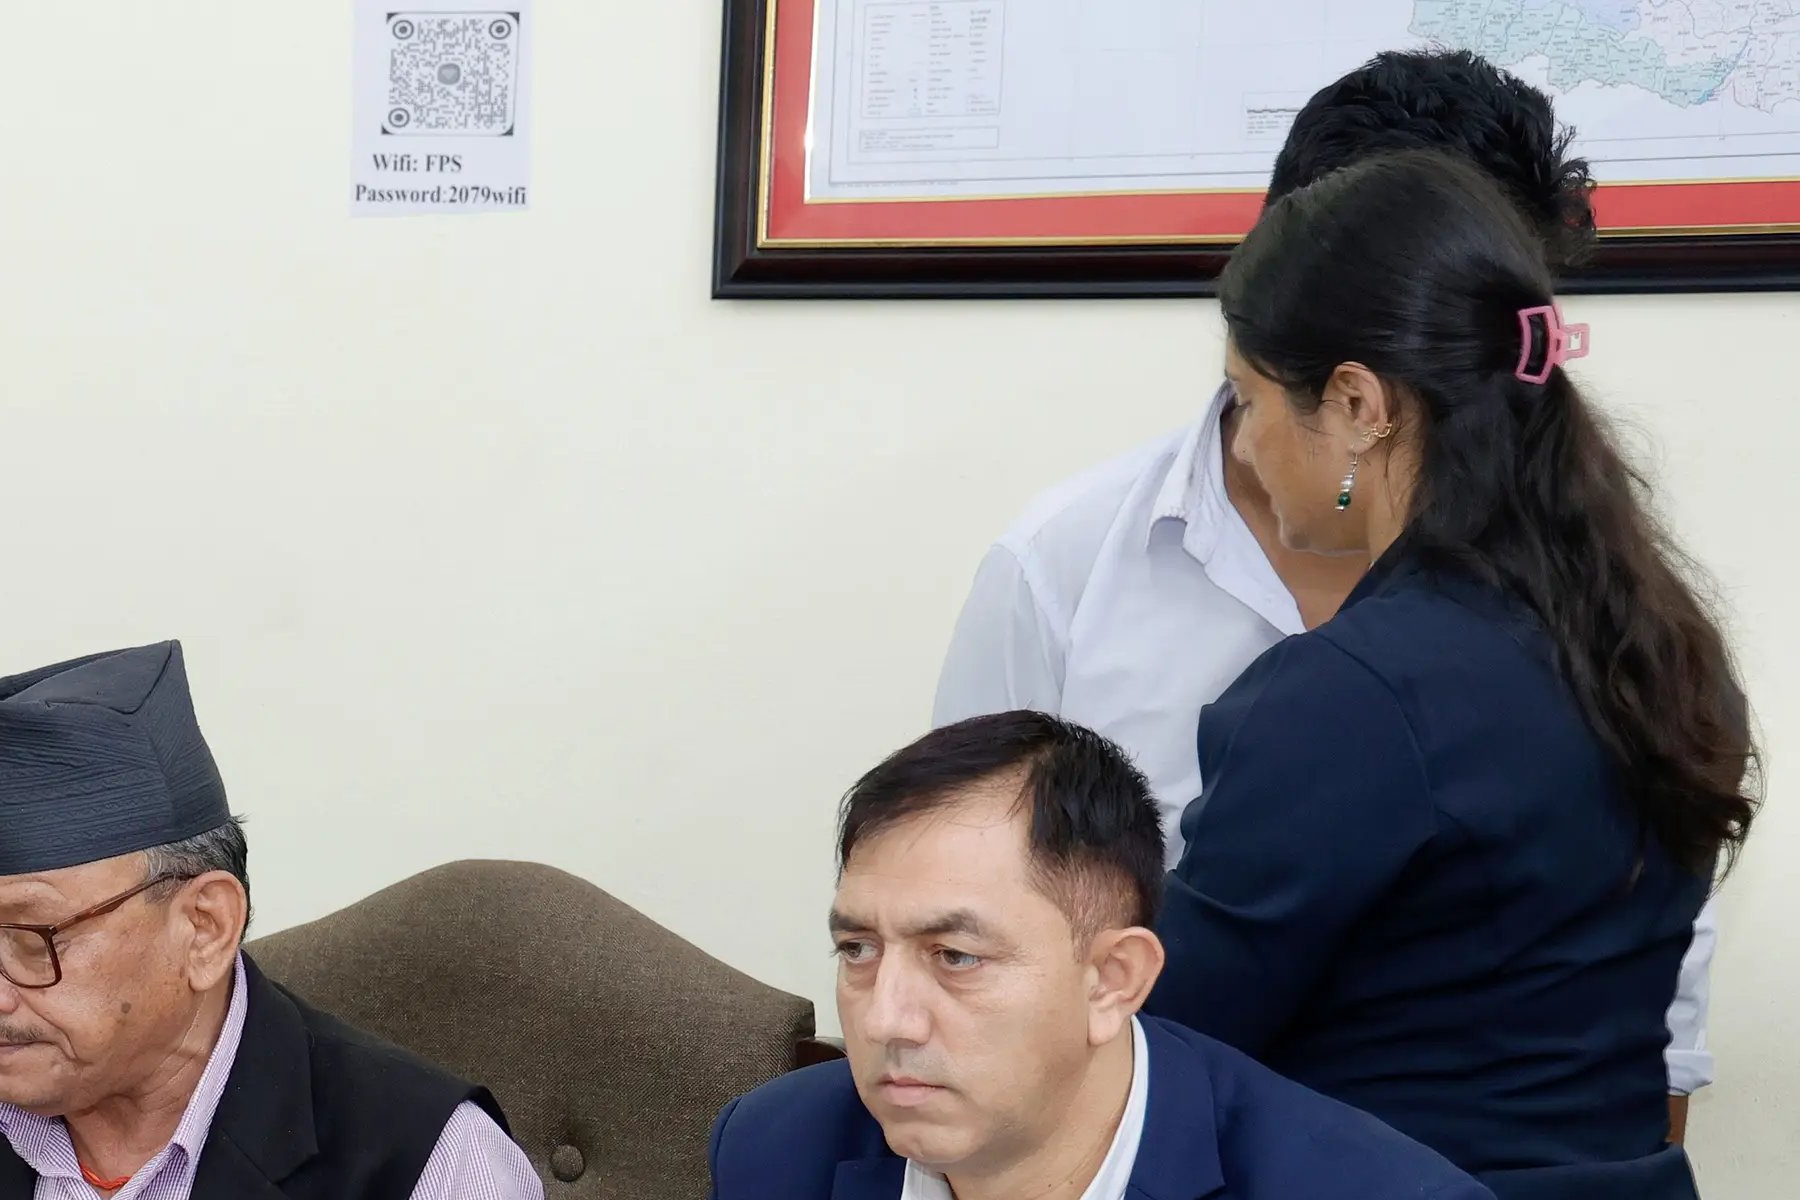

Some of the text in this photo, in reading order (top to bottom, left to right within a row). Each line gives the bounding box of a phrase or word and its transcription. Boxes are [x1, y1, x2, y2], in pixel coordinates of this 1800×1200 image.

[373, 153, 463, 173] Wifi: FPS
[355, 184, 527, 205] Password:2079wifi
